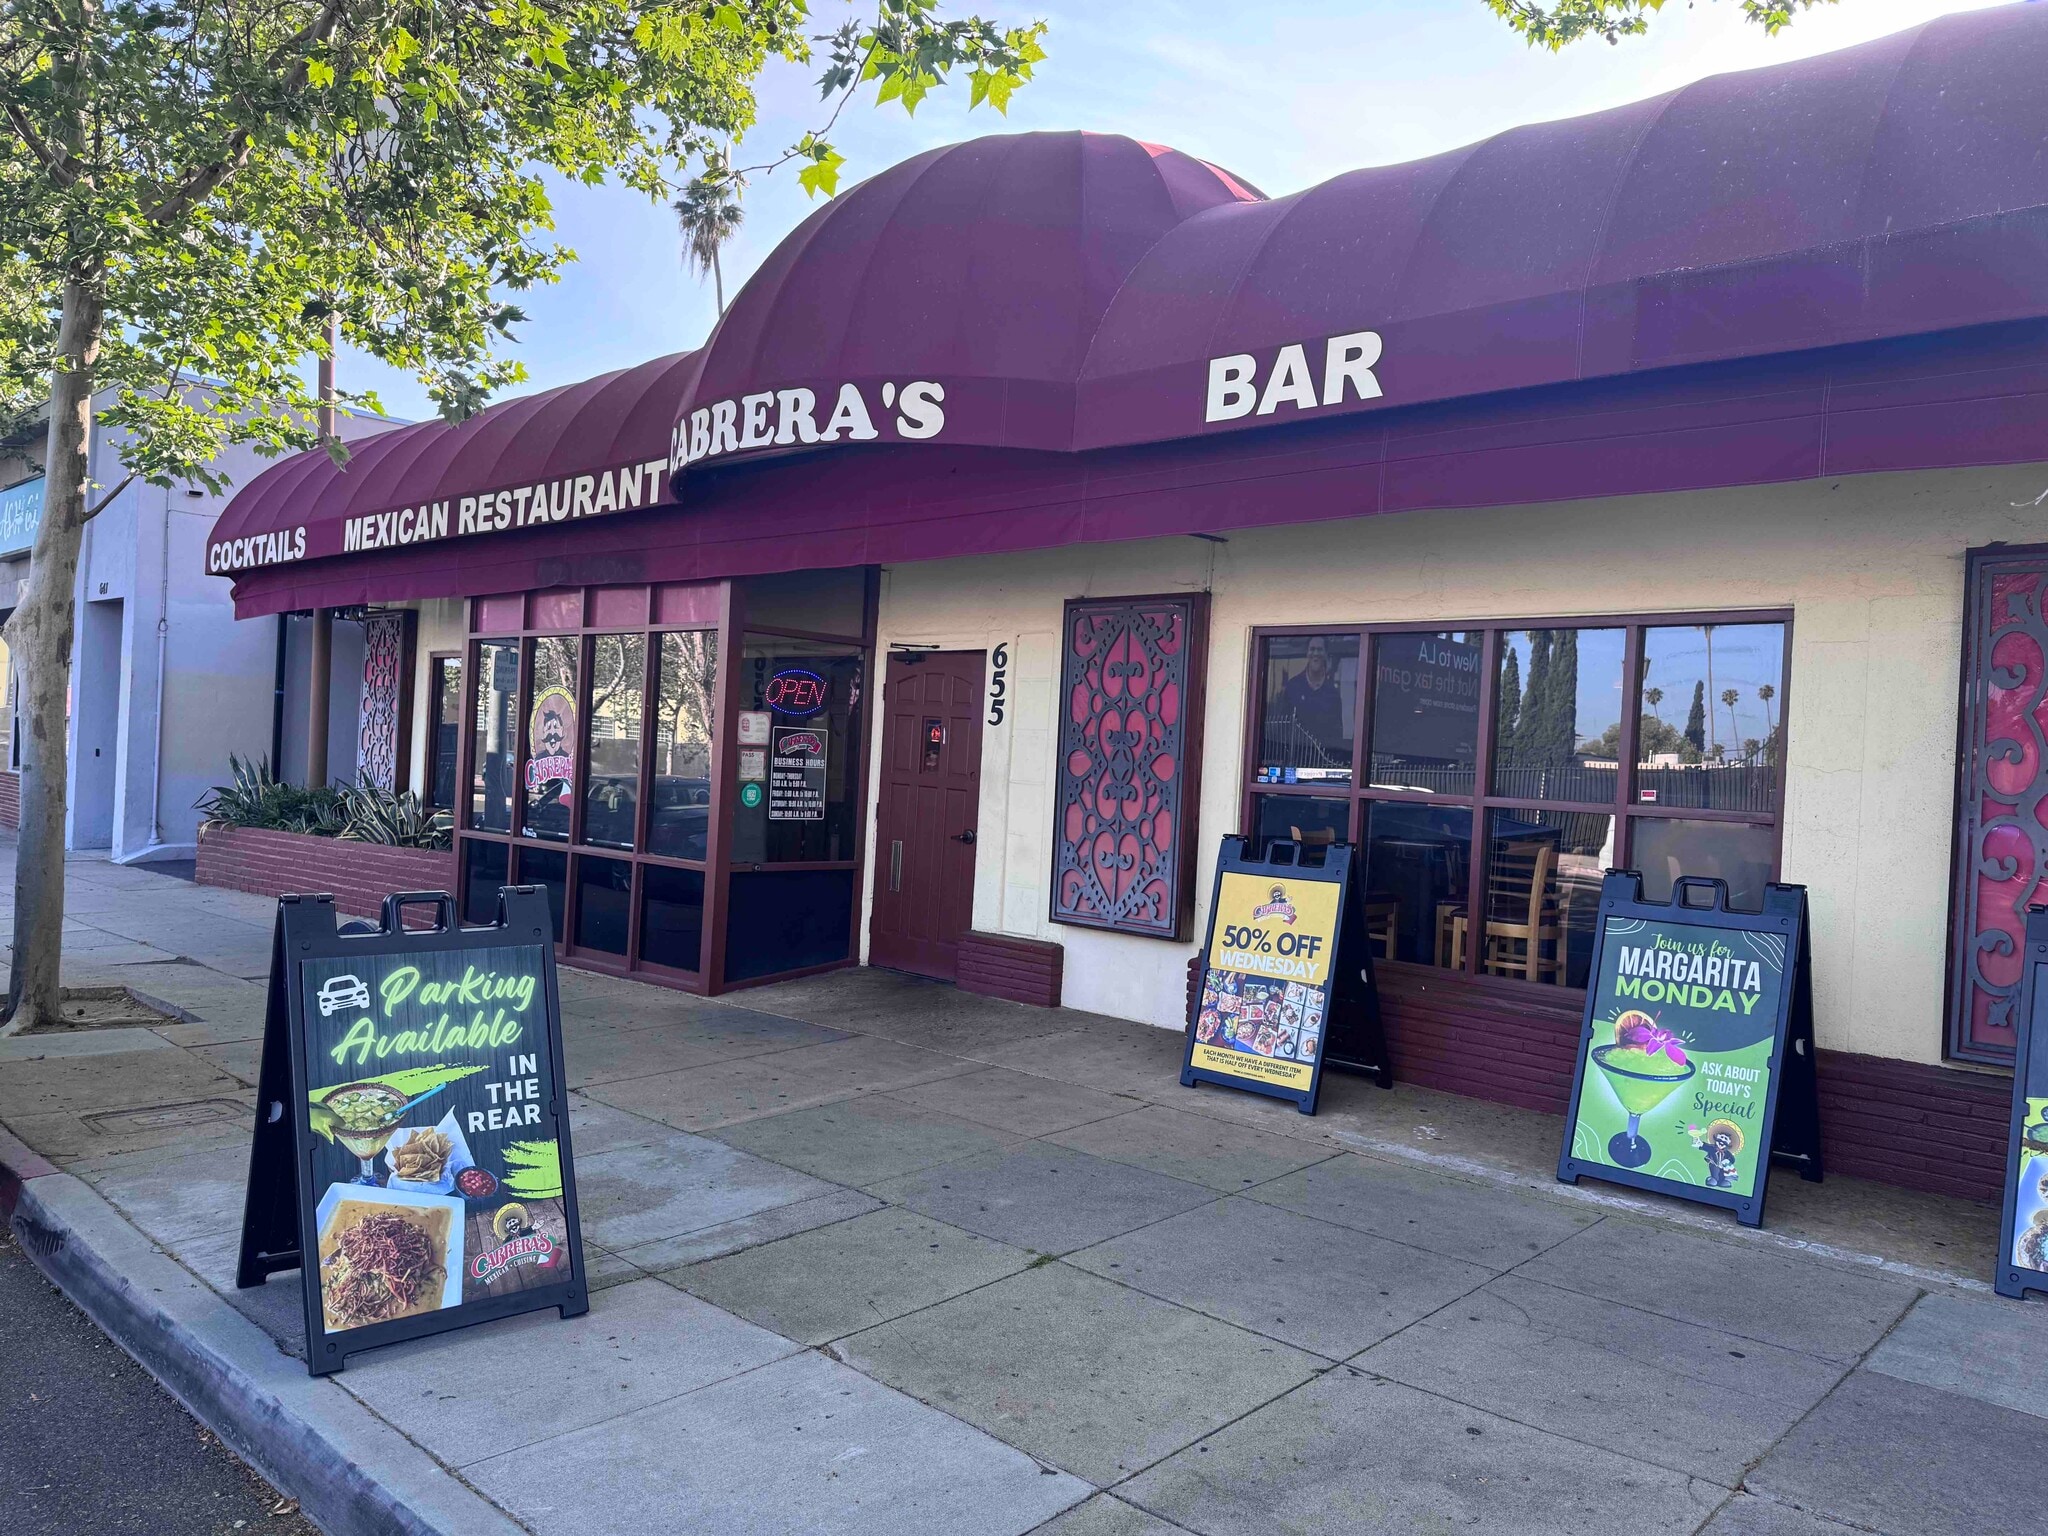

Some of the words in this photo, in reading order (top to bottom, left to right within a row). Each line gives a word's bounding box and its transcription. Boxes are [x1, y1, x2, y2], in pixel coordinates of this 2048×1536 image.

[1205, 331, 1383, 423] BAR
[669, 381, 945, 476] CABRERA'S
[343, 501, 449, 552] MEXICAN
[458, 458, 668, 535] RESTAURANT
[209, 526, 306, 573] COCKTAILS
[766, 678, 827, 705] OPEN
[987, 642, 1008, 726] 655
[774, 757, 804, 766] BUSINESS
[805, 759, 825, 767] HOURS
[1222, 924, 1272, 953] 50%
[1277, 932, 1323, 959] OFF
[1650, 933, 1685, 953] Join
[1687, 942, 1707, 956] us
[1710, 940, 1735, 959] for
[1219, 949, 1320, 980] WEDNESDAY
[1618, 946, 1761, 992] MARGARITA
[380, 965, 536, 1017] Parking
[1615, 975, 1761, 1015] MONDAY
[330, 1008, 523, 1065] Available
[509, 1053, 538, 1076] IN
[1206, 1055, 1219, 1063] THAT
[1224, 1059, 1237, 1067] HALF
[1238, 1061, 1248, 1069] OFF
[1248, 1063, 1264, 1073] EVERY
[1265, 1067, 1297, 1079] WEDNESDAY
[1217, 1051, 1235, 1059] MONTH
[1244, 1056, 1258, 1065] HAVE
[1263, 1061, 1289, 1072] DIFFERENT
[1289, 1066, 1302, 1074] ITEM
[1701, 1061, 1723, 1077] ASK
[1724, 1065, 1761, 1083] ABOUT
[485, 1078, 540, 1104] THE
[1706, 1078, 1751, 1098] TODAY'S
[467, 1104, 542, 1133] REAR
[1693, 1091, 1756, 1120] Special
[471, 1232, 553, 1278] CABRERA'S
[484, 1264, 510, 1286] MEXICAN
[513, 1255, 537, 1268] CUISINE
